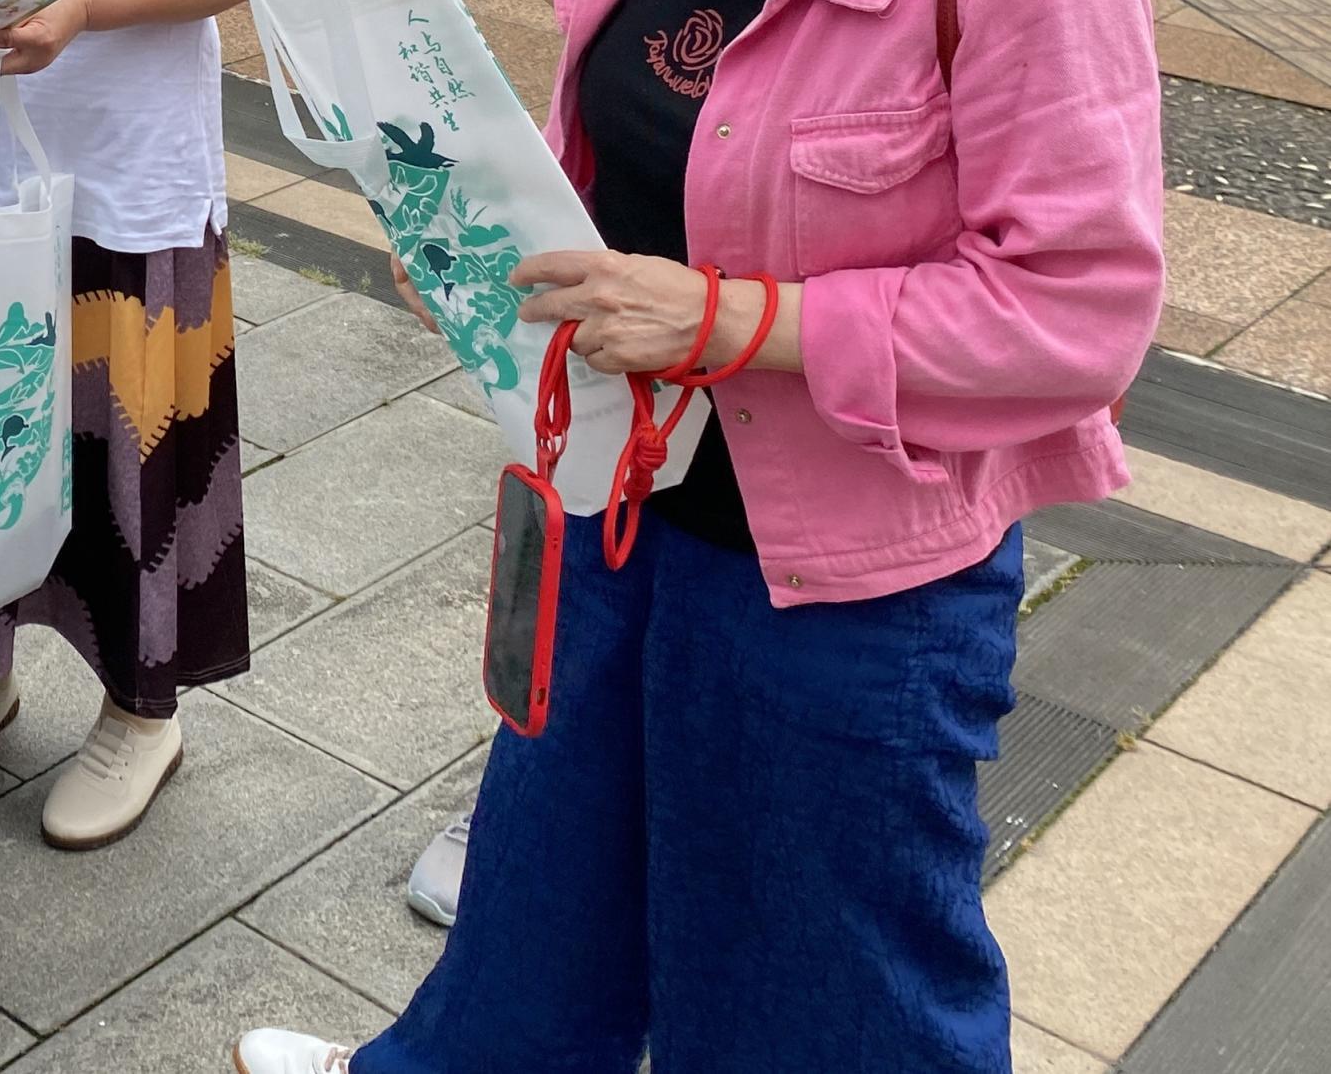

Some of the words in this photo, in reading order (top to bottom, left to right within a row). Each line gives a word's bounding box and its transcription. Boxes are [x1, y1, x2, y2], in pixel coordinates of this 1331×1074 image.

[398, 41, 460, 132] 和谐共生
[408, 9, 476, 103] 人与自然
